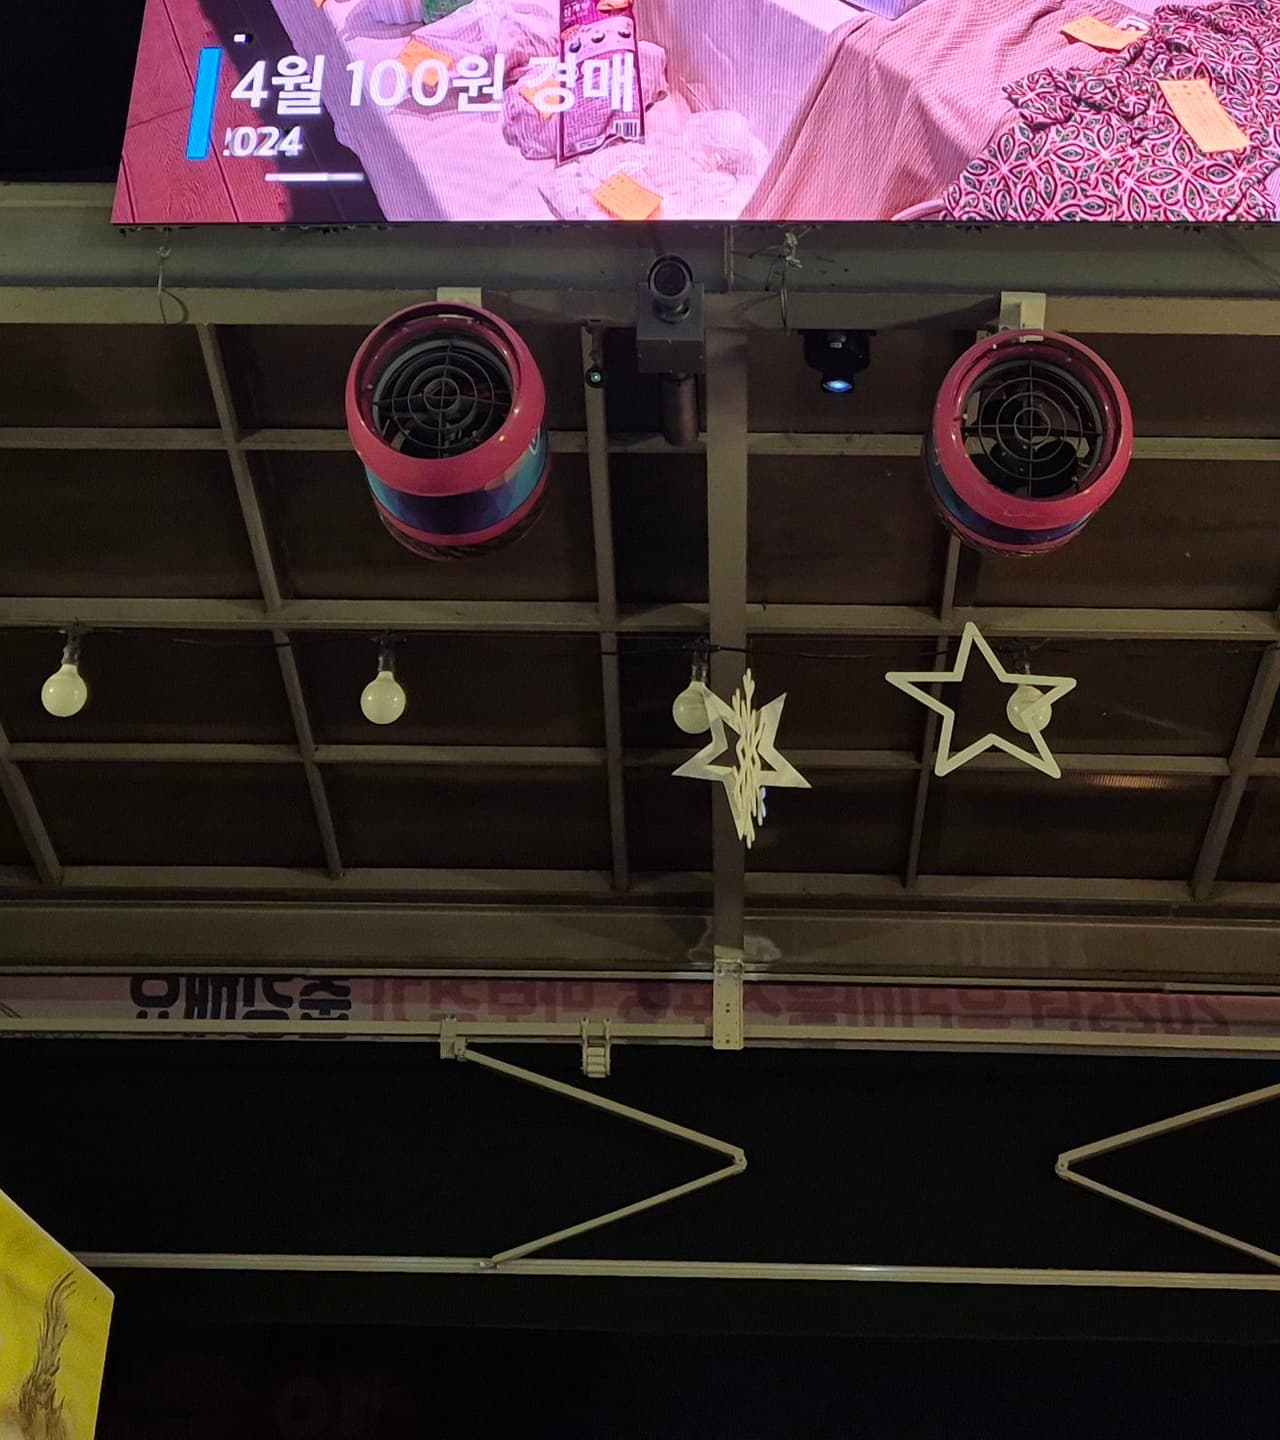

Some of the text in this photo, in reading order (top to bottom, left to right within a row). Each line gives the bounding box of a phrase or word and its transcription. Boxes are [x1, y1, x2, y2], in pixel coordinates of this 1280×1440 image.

[231, 51, 635, 116] 4월 100원 경매
